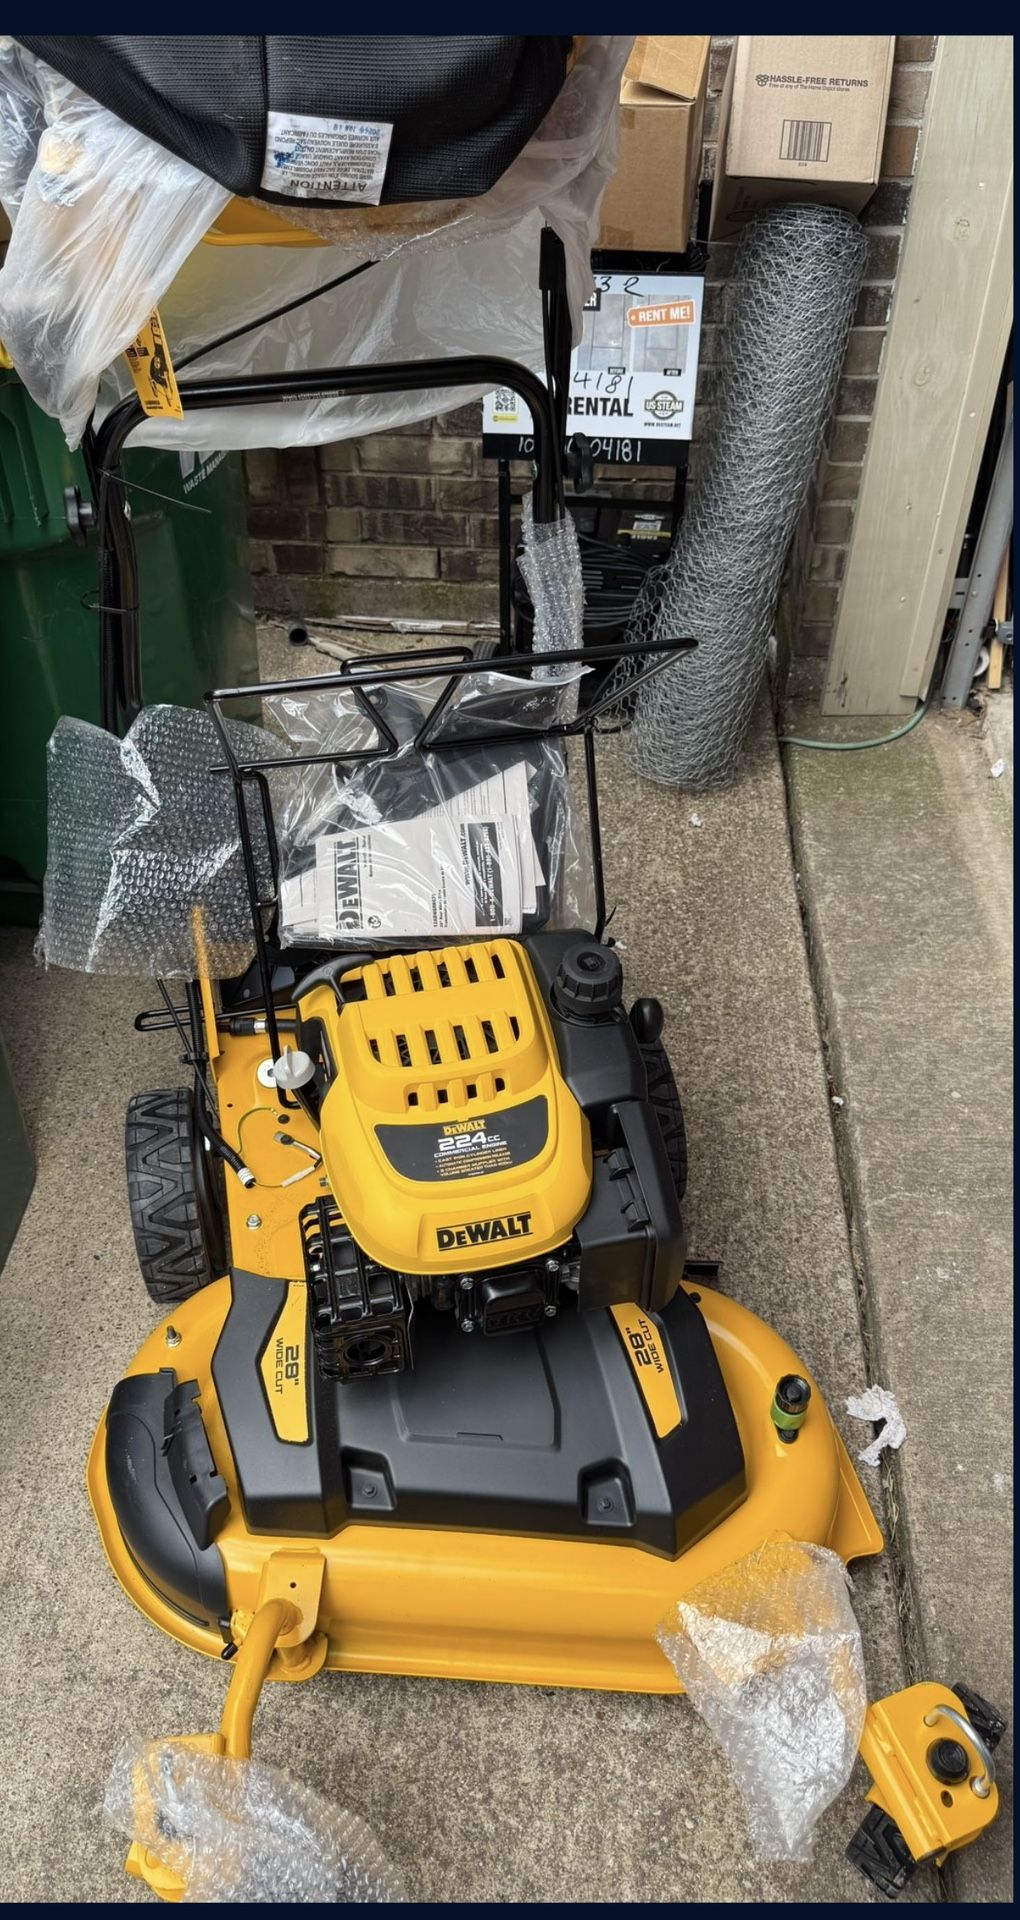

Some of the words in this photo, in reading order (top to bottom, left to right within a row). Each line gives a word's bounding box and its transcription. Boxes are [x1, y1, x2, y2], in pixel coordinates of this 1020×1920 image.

[770, 74, 827, 85] HASSLE-FREE
[829, 78, 869, 88] RETURNS
[290, 180, 367, 192] ATTENTION
[639, 308, 668, 322] RENT
[669, 305, 691, 320] ME!
[573, 371, 634, 399] 4181
[646, 401, 656, 410] US
[657, 401, 683, 411] STEAM
[183, 468, 207, 495] WASTE
[443, 1119, 486, 1136] DEWALT
[433, 1146, 480, 1158] COMMERCIAL
[482, 1141, 507, 1149] ENGINE
[436, 1213, 532, 1250] DEWALT
[638, 1318, 652, 1341] CUT
[275, 1337, 284, 1368] WIDE
[625, 1327, 652, 1366] 28"
[648, 1343, 664, 1373] WIDE
[285, 1344, 300, 1386] 28"
[275, 1371, 283, 1394] CUT
